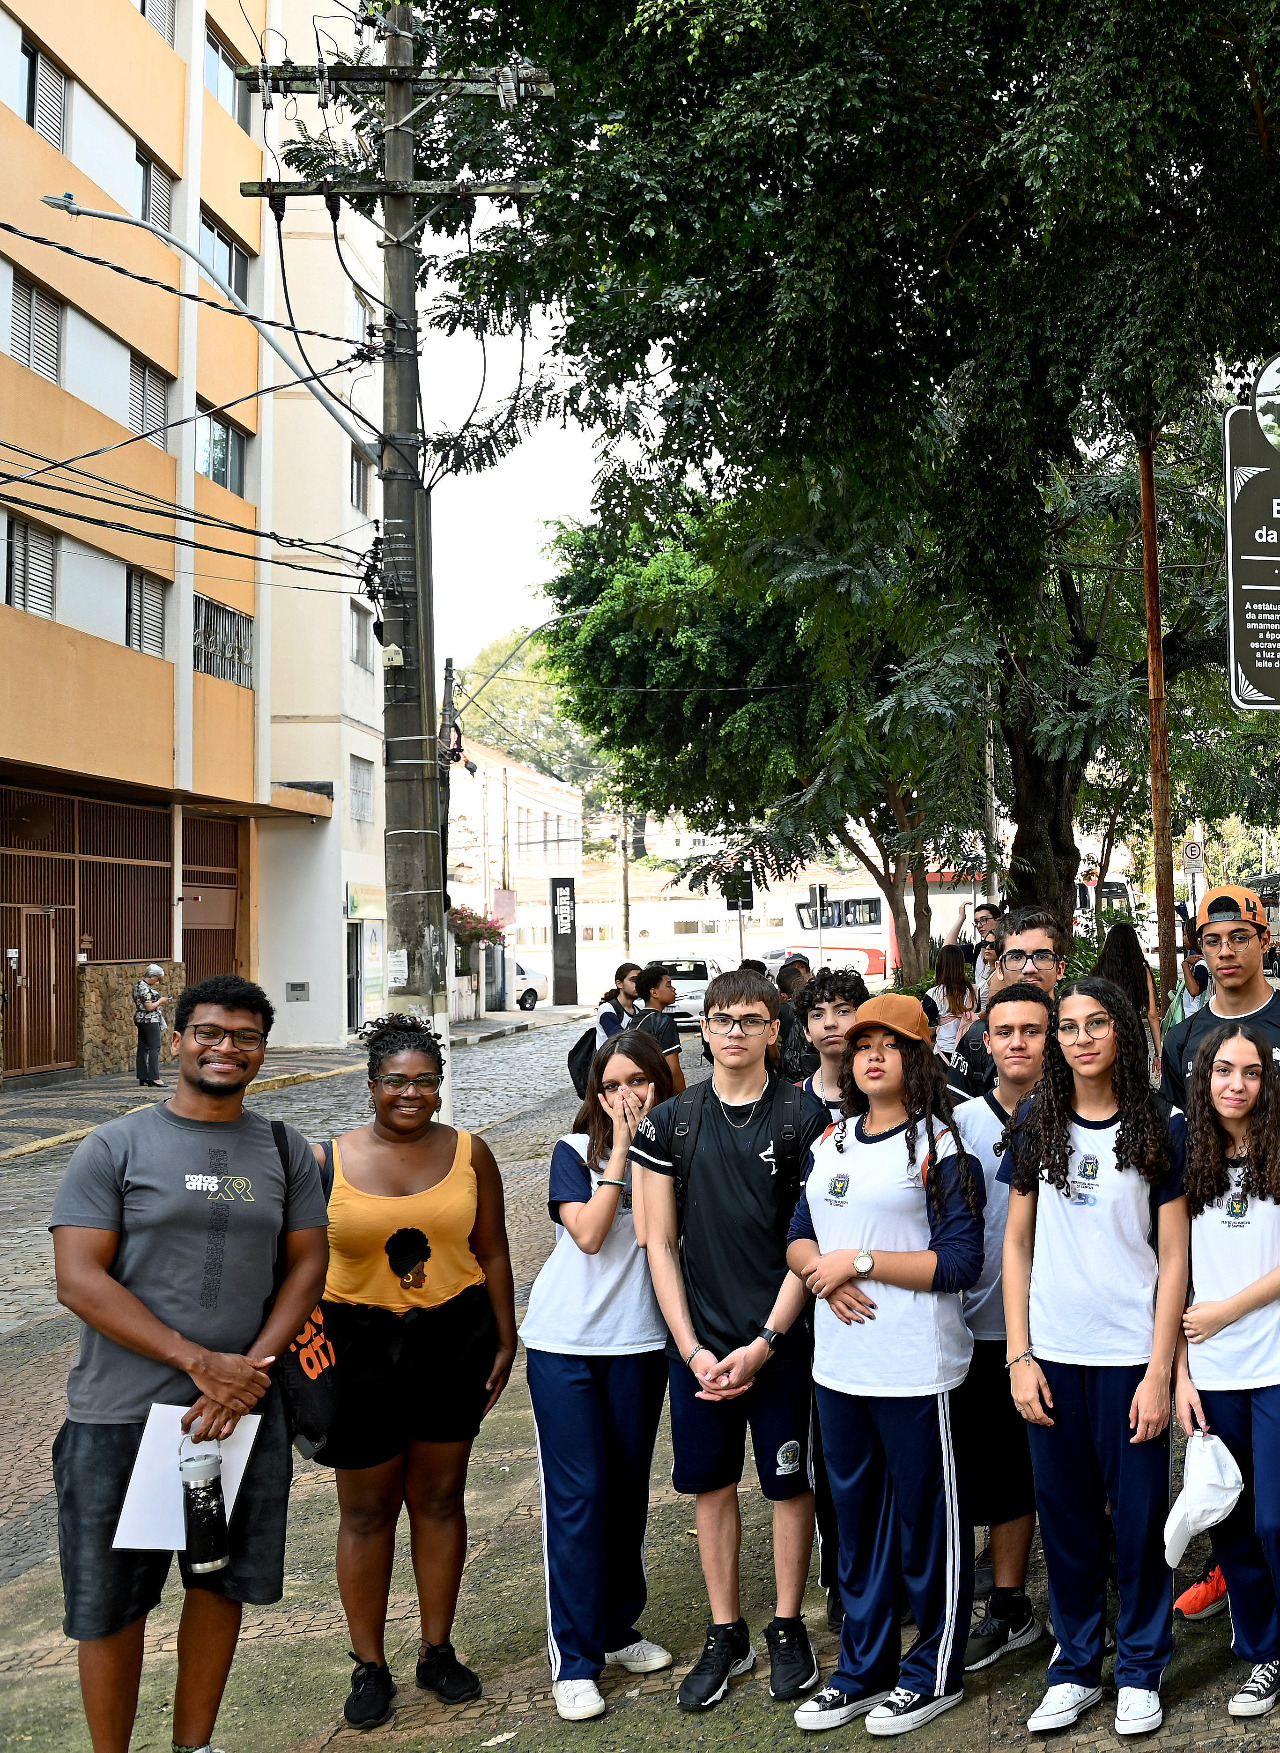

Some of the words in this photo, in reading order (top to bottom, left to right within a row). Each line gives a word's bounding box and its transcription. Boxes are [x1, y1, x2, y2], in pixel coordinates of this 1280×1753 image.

[1255, 526, 1278, 542] da
[1245, 602, 1251, 610] A
[1263, 650, 1274, 658] luz
[560, 887, 571, 934] NOBRE
